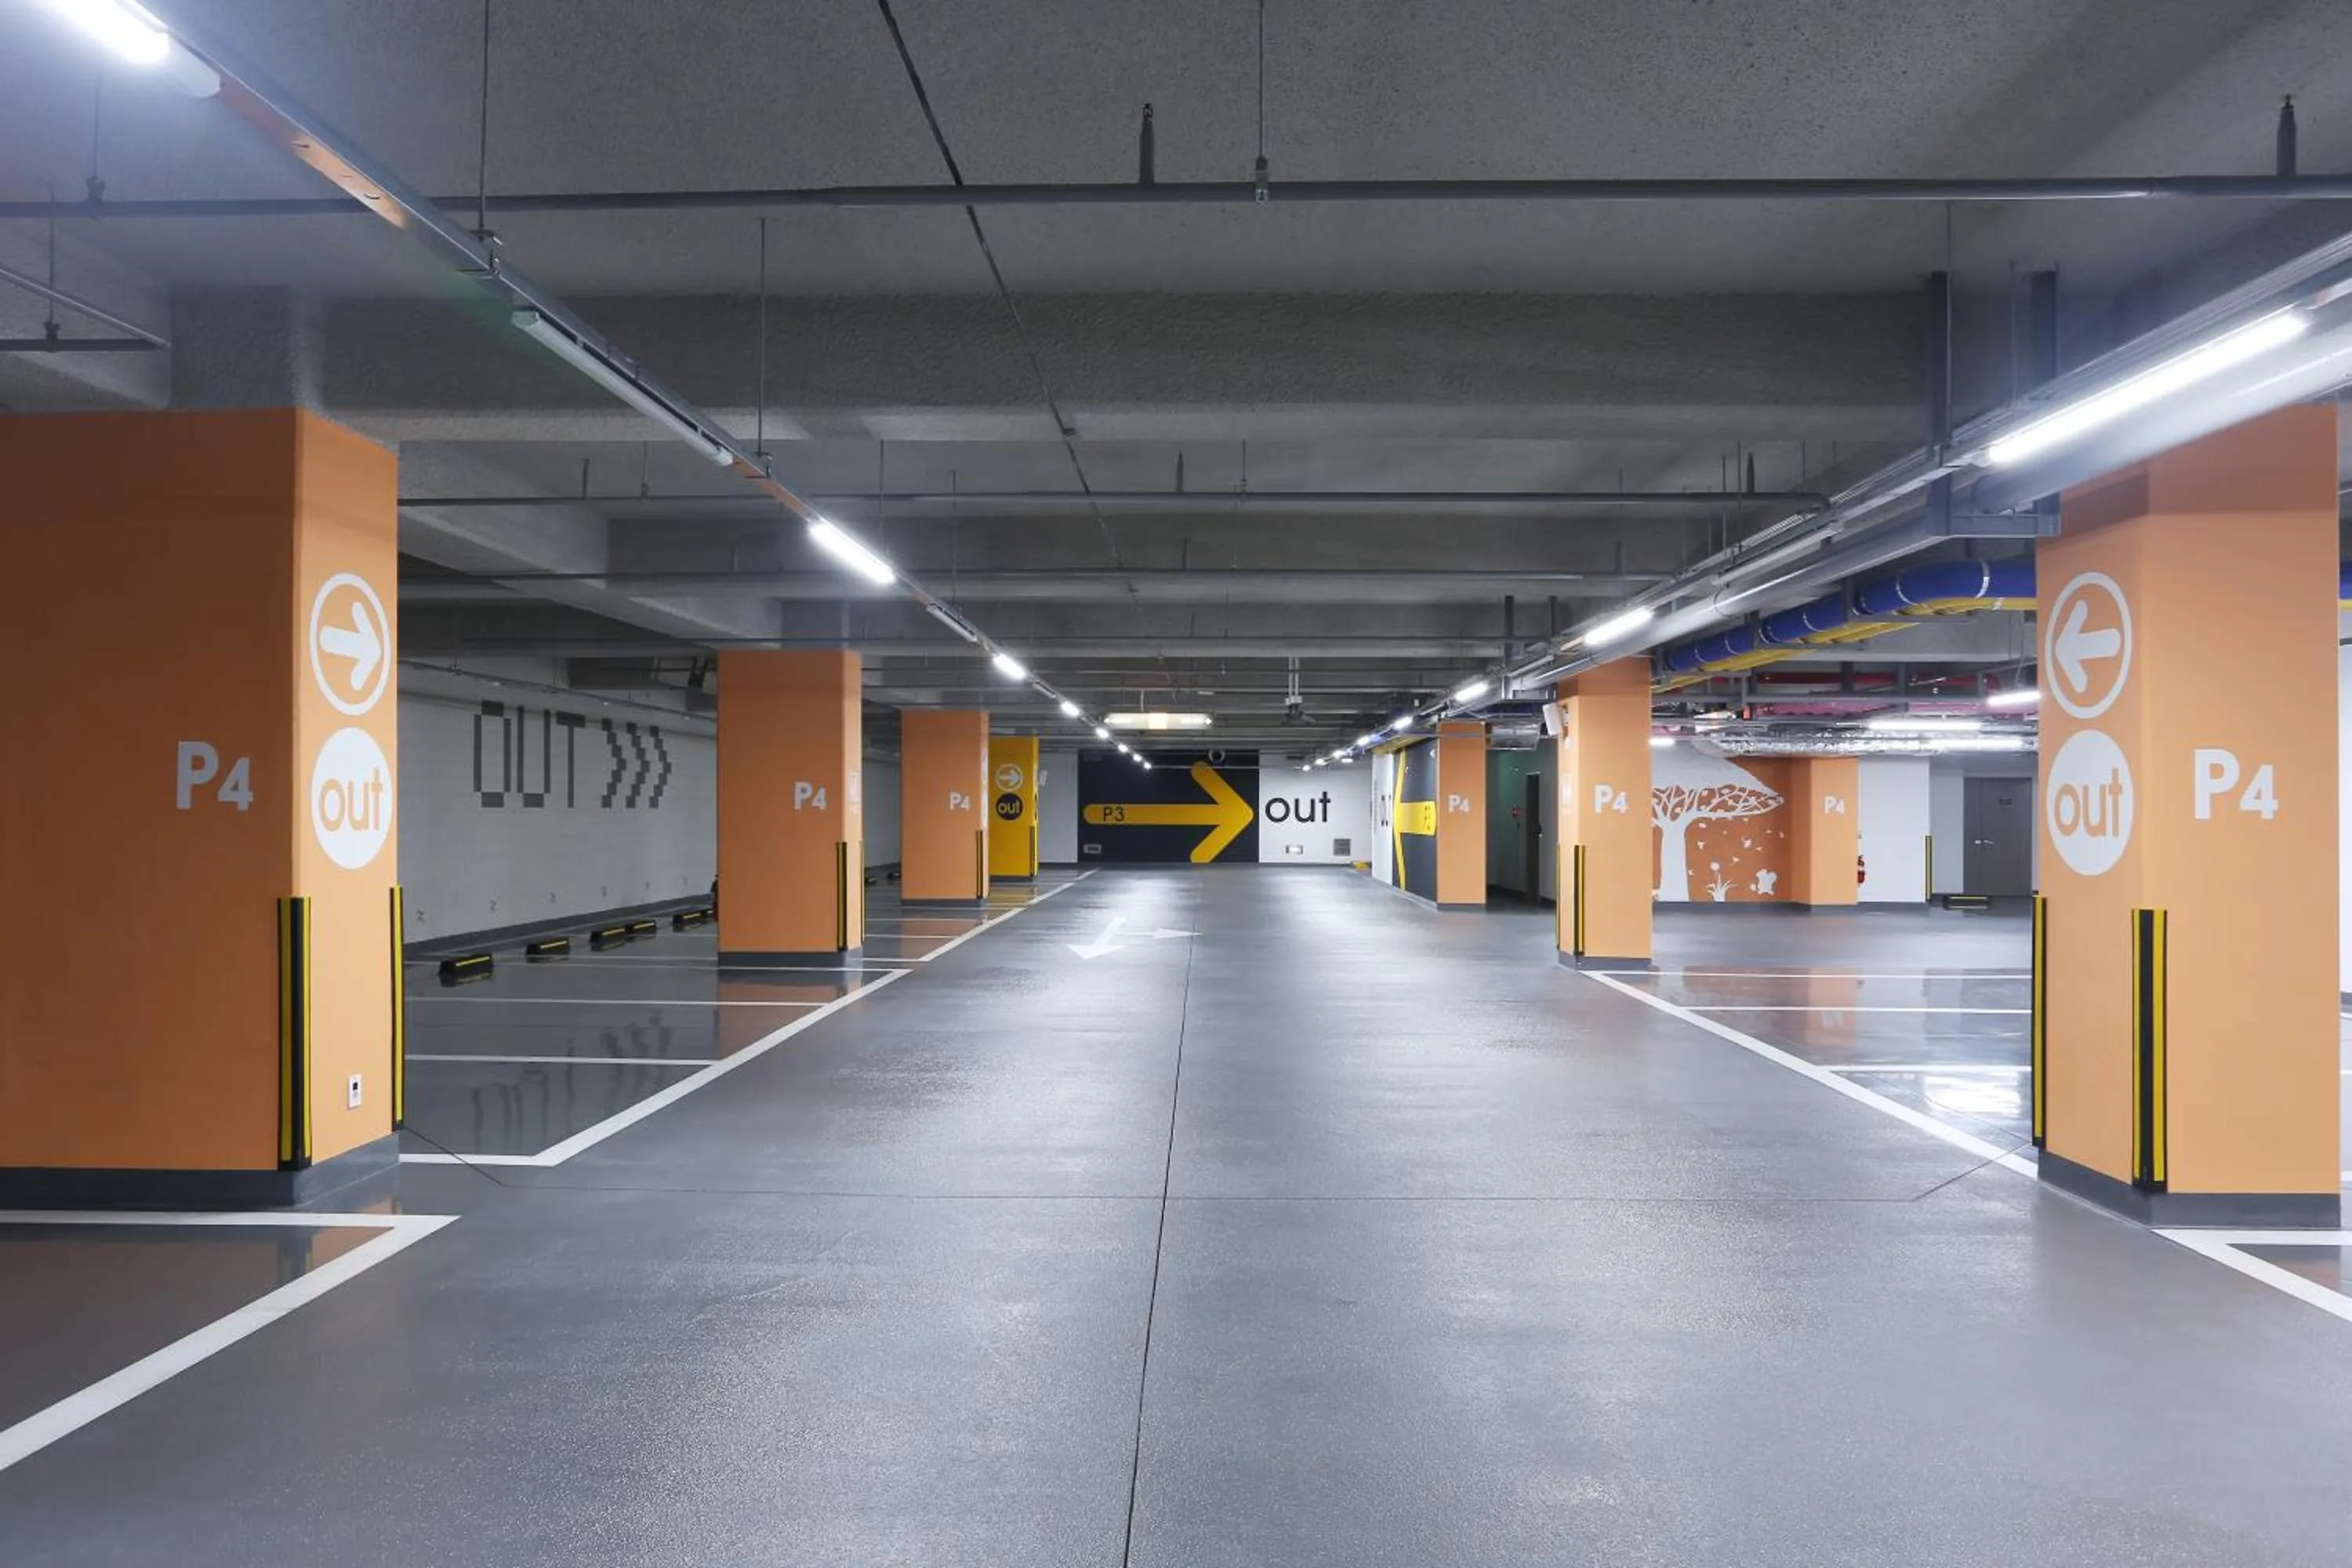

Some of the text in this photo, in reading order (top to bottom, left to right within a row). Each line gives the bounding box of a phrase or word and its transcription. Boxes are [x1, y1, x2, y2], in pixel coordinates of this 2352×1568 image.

[176, 741, 253, 811] P4
[2194, 748, 2279, 820] P4
[318, 769, 383, 832] out
[793, 782, 827, 811] P4
[949, 793, 970, 810] P4
[997, 800, 1020, 814] out
[1265, 791, 1331, 822] out
[1449, 795, 1470, 812] P4
[1594, 784, 1628, 815] P4
[1824, 797, 1846, 815] P4
[2053, 768, 2123, 837] out
[1103, 807, 1124, 822] P3
